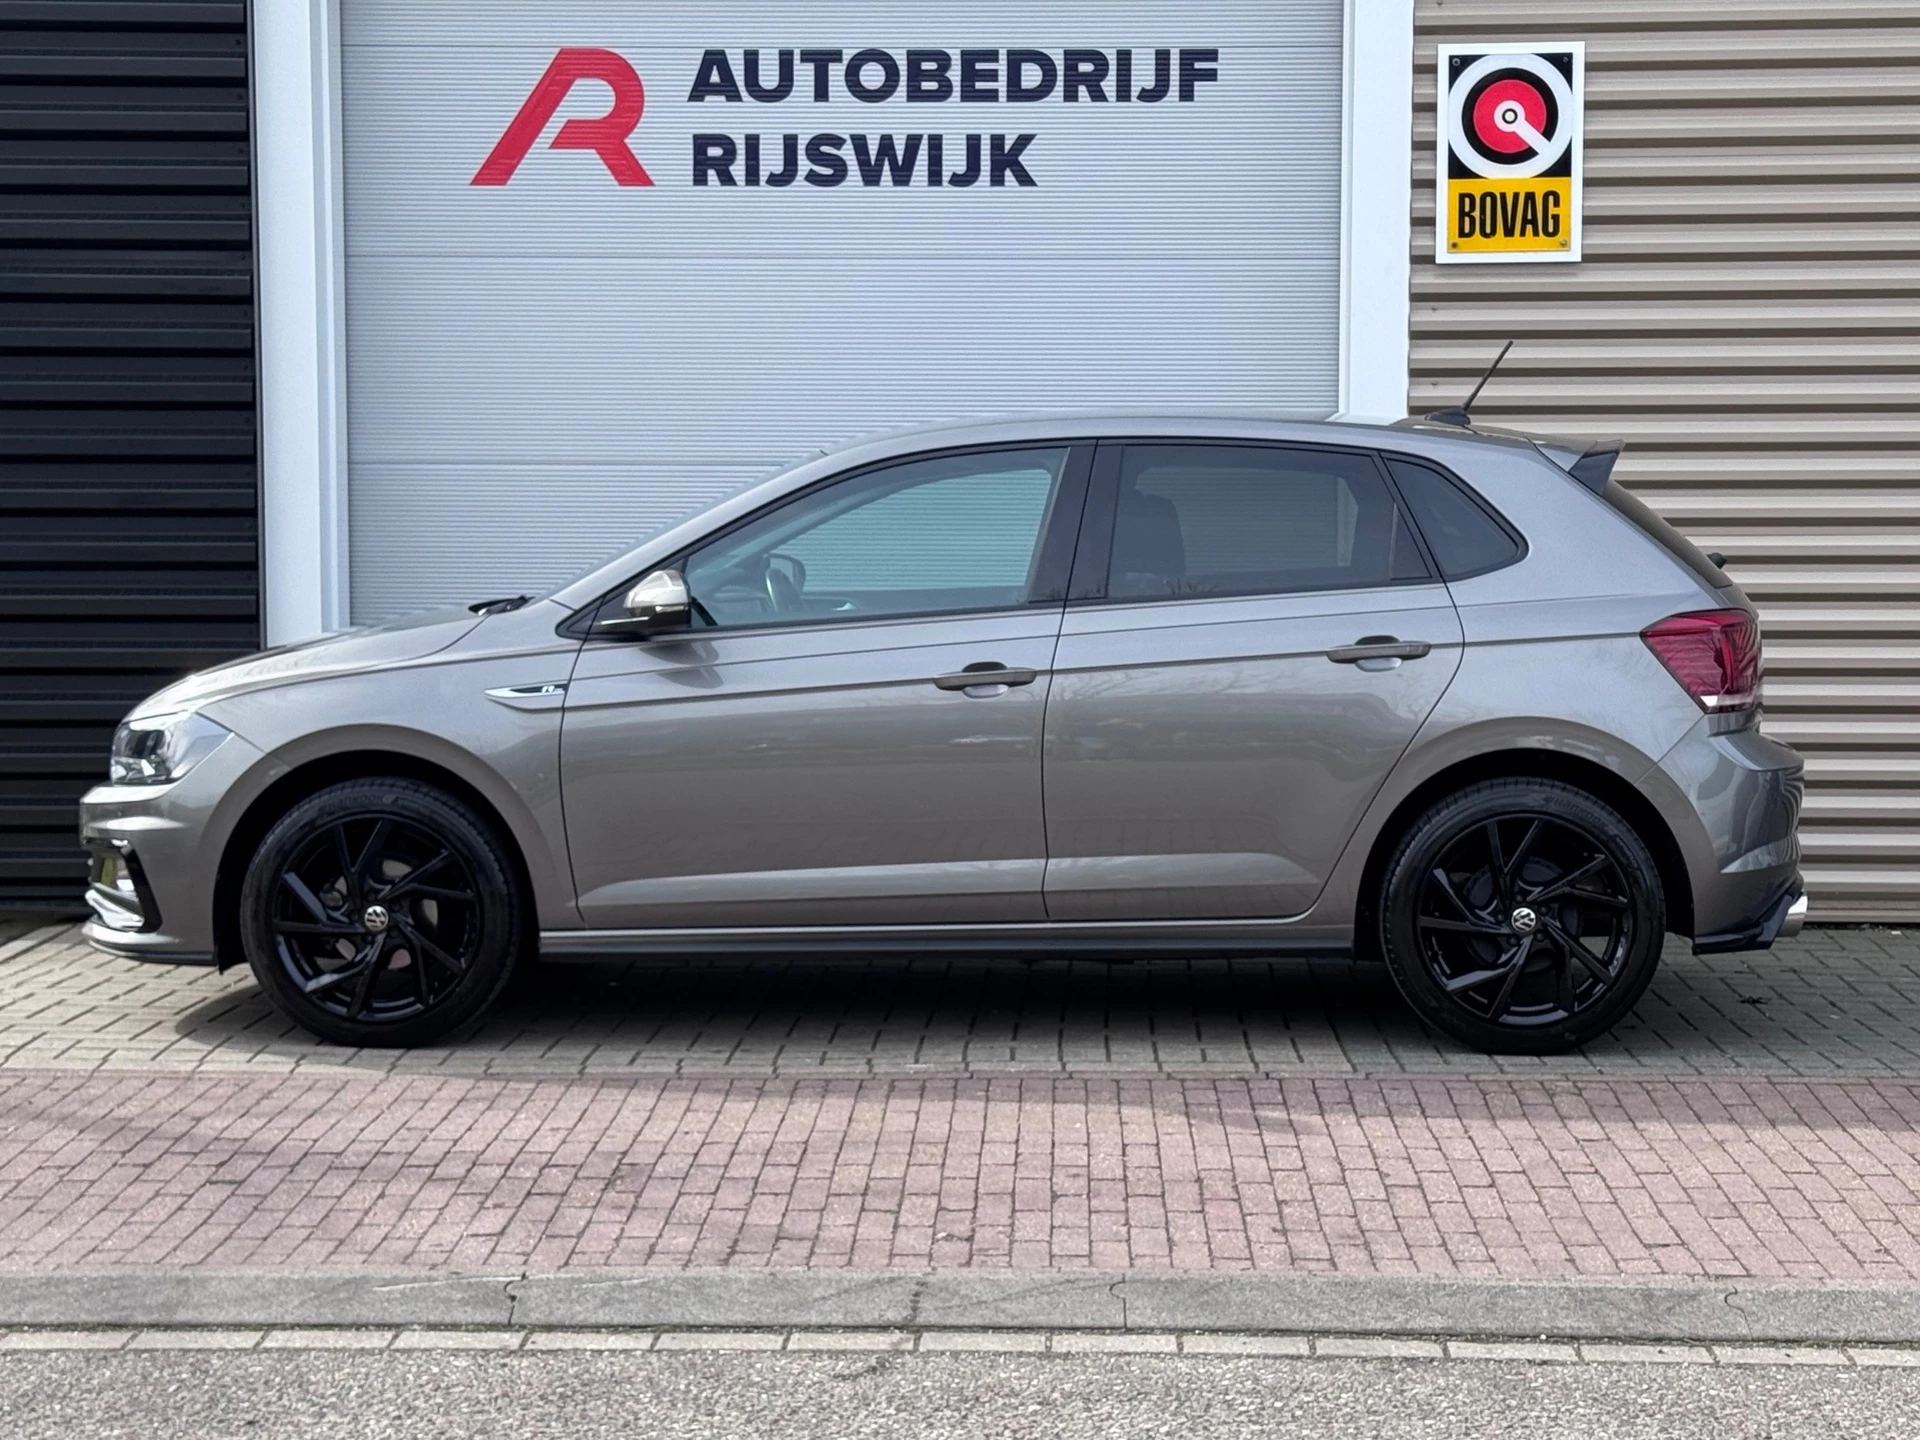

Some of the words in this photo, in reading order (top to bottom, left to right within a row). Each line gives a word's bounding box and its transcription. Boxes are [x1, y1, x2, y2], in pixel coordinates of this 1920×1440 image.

[687, 49, 1218, 103] AUTOBEDRIJF
[693, 134, 1037, 187] RIJSWIJK
[1457, 190, 1561, 239] BOVAG
